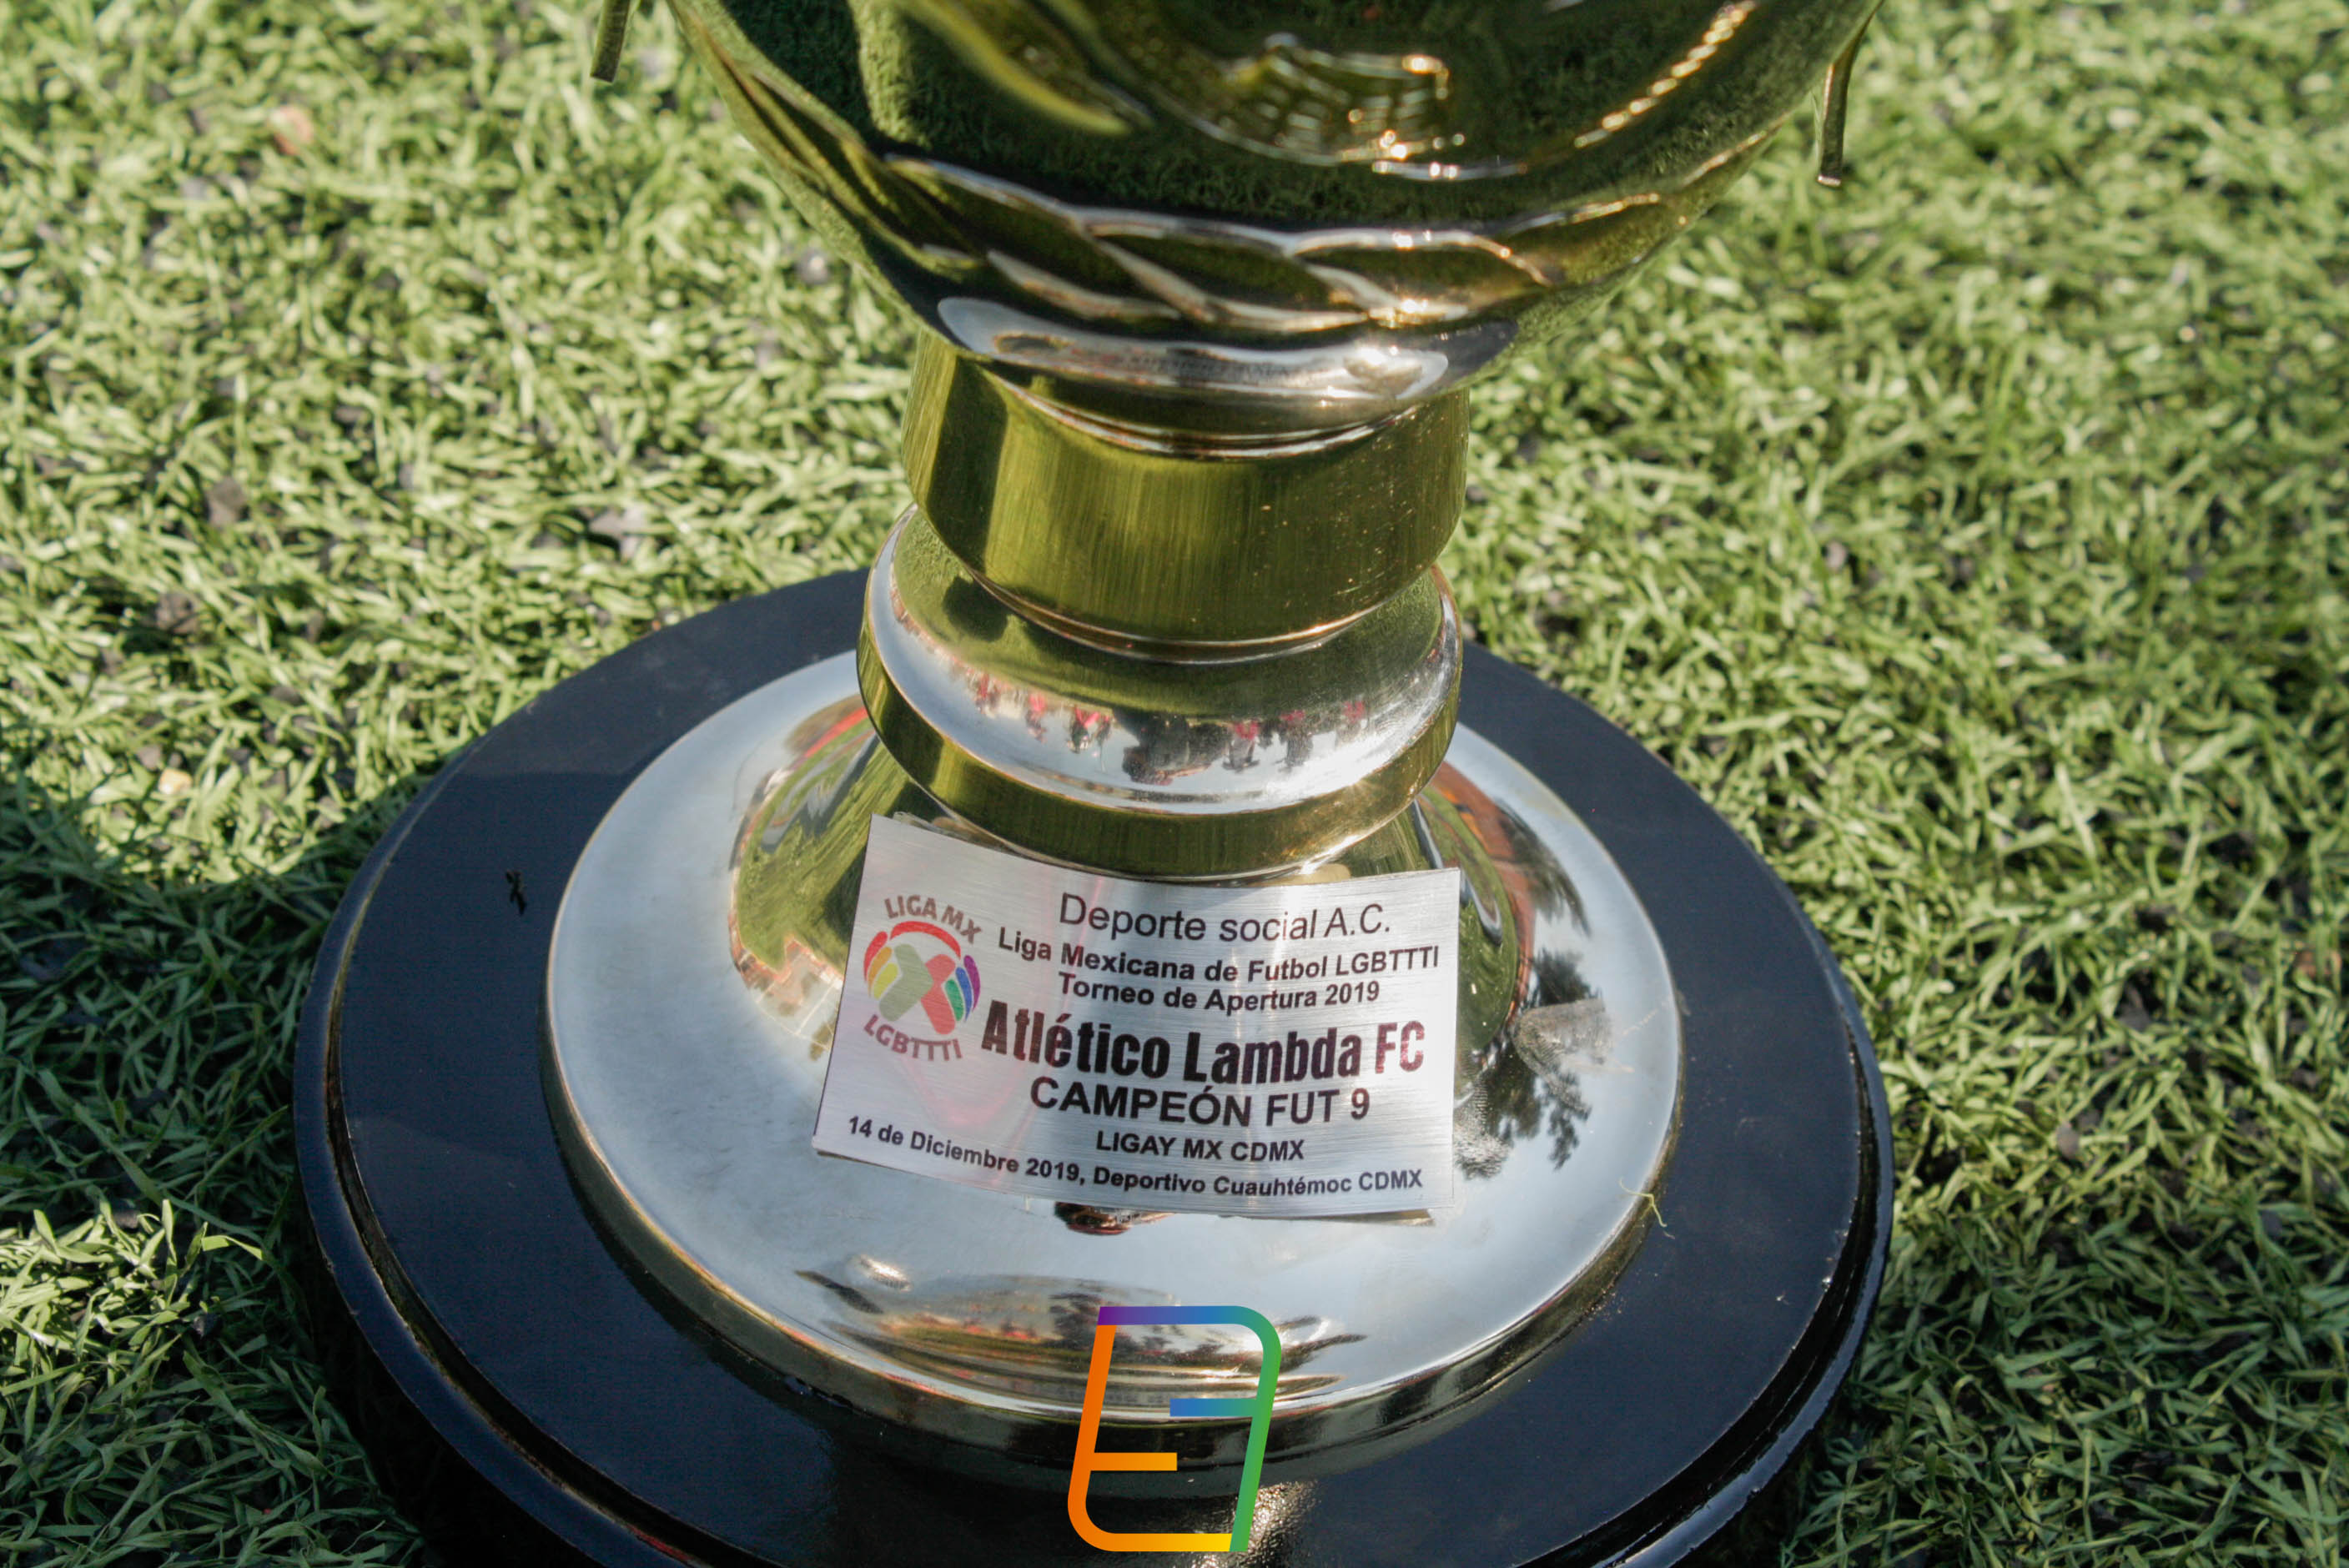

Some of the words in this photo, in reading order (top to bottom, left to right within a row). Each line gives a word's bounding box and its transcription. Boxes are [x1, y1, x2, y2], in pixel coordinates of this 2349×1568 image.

[884, 895, 938, 920] LIGA
[940, 905, 983, 945] MX
[1059, 892, 1206, 940] Deporte
[1219, 909, 1317, 942] social
[1324, 903, 1390, 937] A.C.
[998, 927, 1052, 961] Liga
[1060, 942, 1195, 980] Mexicana
[1205, 960, 1238, 981] de
[1248, 956, 1328, 983] Futbol
[1335, 945, 1439, 976] LGBTTTI
[1059, 971, 1154, 1005] Torneo
[1164, 987, 1197, 1008] de
[1204, 988, 1317, 1017] Apertura
[1325, 981, 1380, 1006] 2019
[863, 1014, 963, 1062] LGBTTTI
[981, 1000, 1170, 1078] Atlético
[1183, 1028, 1362, 1084] Lambda
[1375, 1021, 1426, 1074] FC
[1030, 1076, 1252, 1127] CAMPEÓN
[1266, 1089, 1340, 1126] FUT
[1351, 1088, 1371, 1120] 9
[849, 1116, 873, 1138] 14
[878, 1124, 903, 1145] de
[910, 1131, 1019, 1173] Diciembre
[1025, 1158, 1084, 1186] 2019,
[1094, 1165, 1205, 1194] Deportivo
[1214, 1176, 1352, 1197] Cuauhtémoc
[1359, 1169, 1423, 1191] CDMX
[1096, 1131, 1177, 1157] LIGAY
[1183, 1138, 1224, 1160] MX
[1230, 1139, 1305, 1162] CDMX
